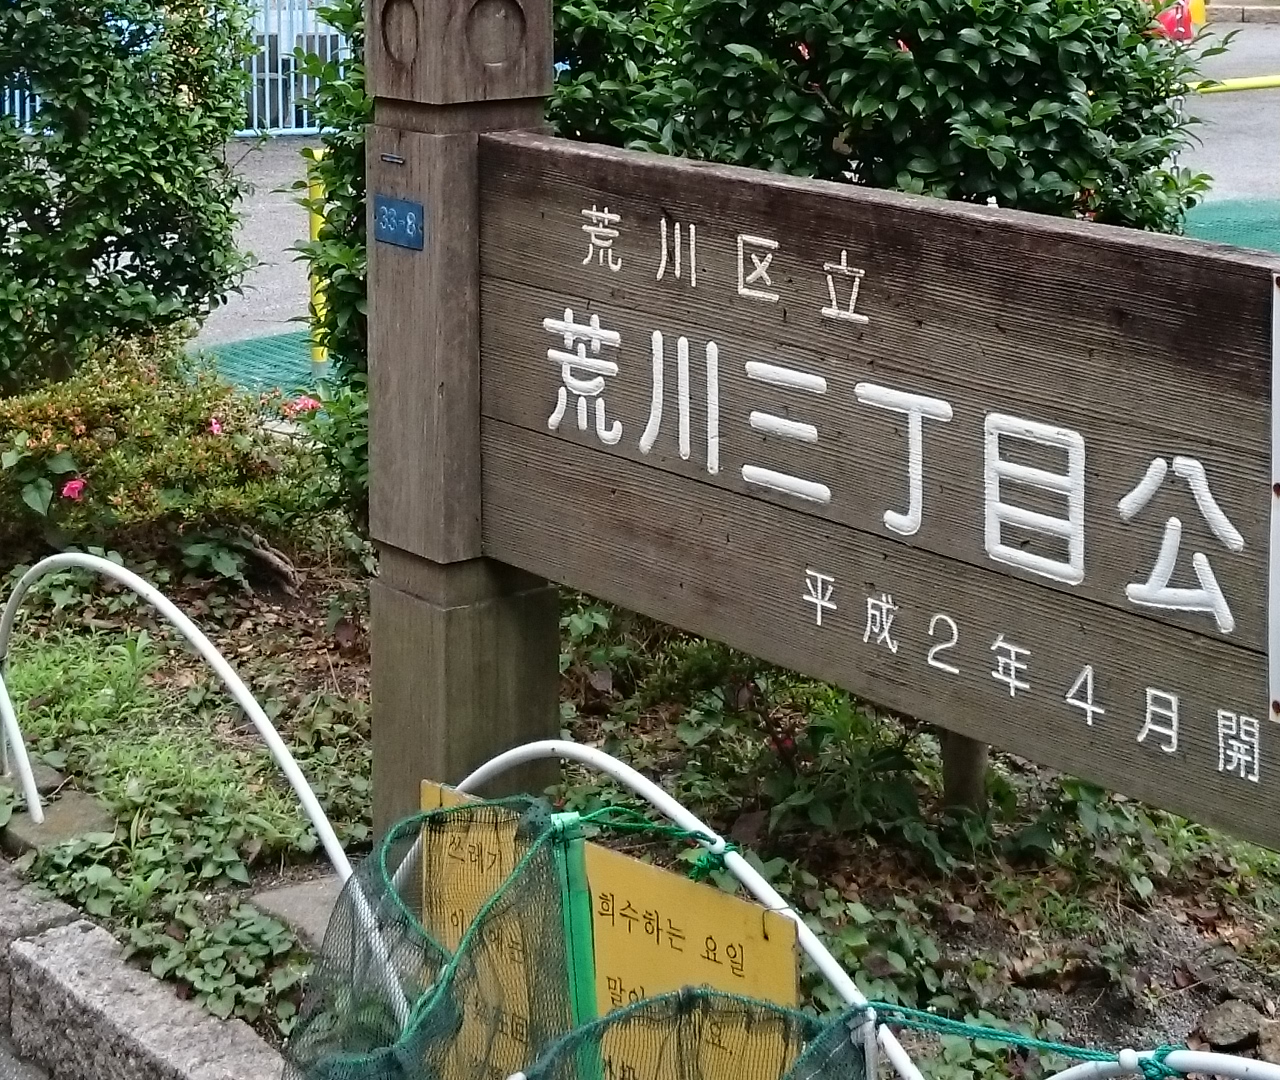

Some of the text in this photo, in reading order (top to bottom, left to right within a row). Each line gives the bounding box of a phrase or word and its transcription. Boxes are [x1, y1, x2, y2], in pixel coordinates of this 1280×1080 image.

[580, 205, 870, 325] 荒川区立
[542, 306, 1247, 634] 荒川三丁目公
[699, 934, 746, 980] 요일
